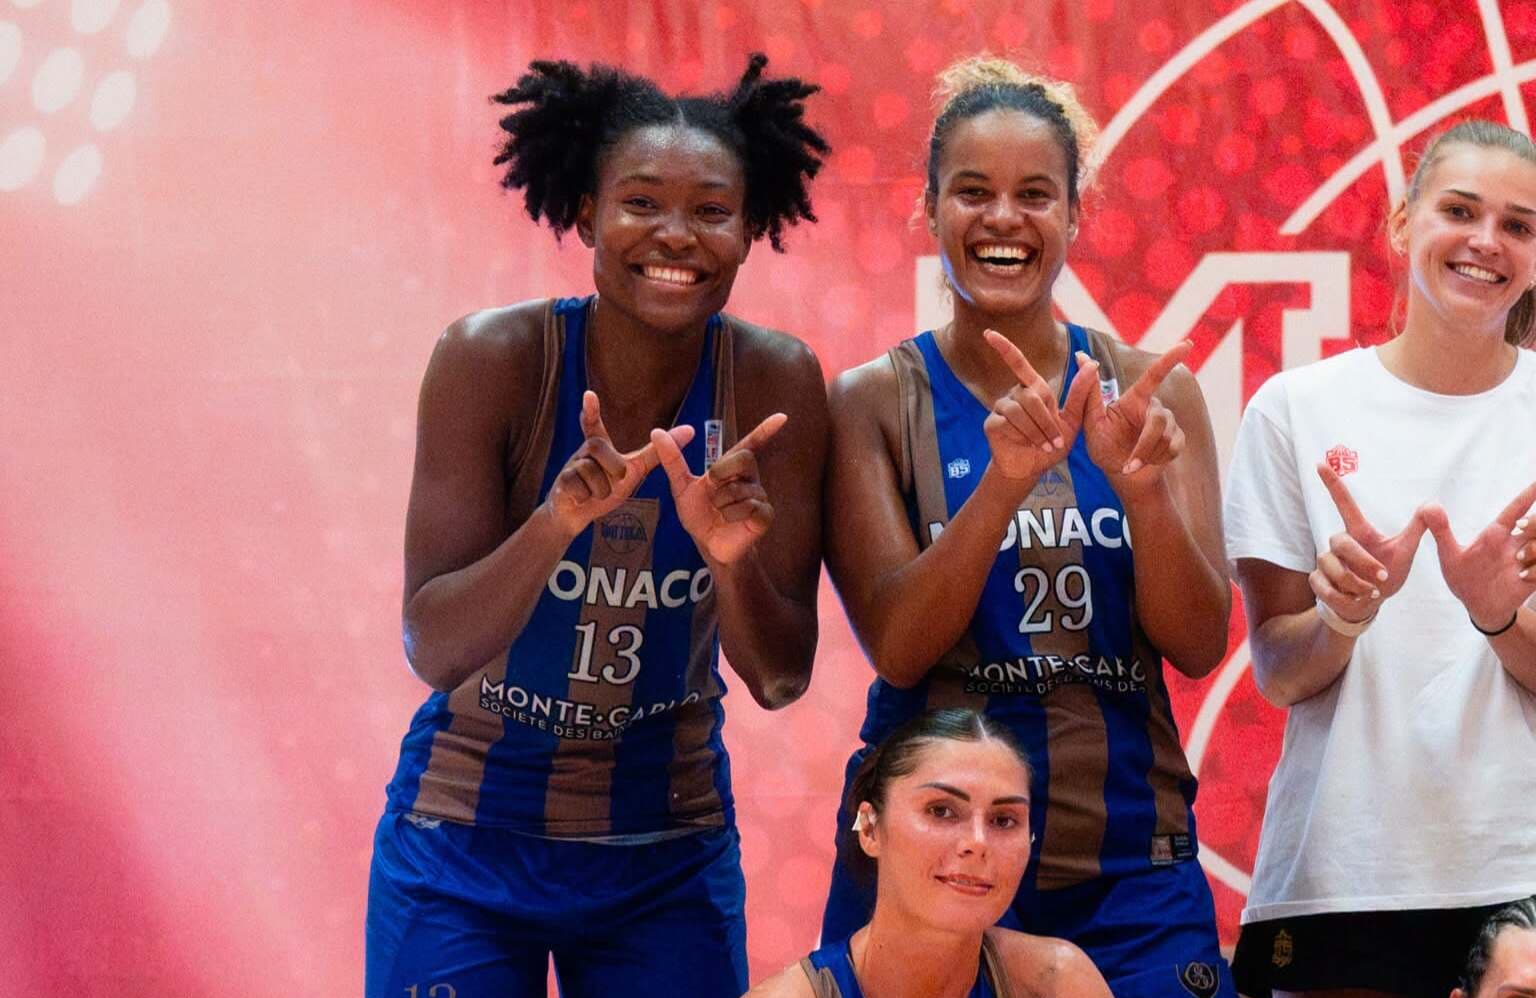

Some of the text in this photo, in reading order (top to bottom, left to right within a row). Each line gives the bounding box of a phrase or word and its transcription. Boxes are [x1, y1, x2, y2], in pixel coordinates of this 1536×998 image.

[929, 507, 1132, 551] NAC
[548, 560, 712, 609] ONACO
[1014, 564, 1094, 634] 29
[567, 621, 644, 685] 13
[553, 725, 585, 739] DES
